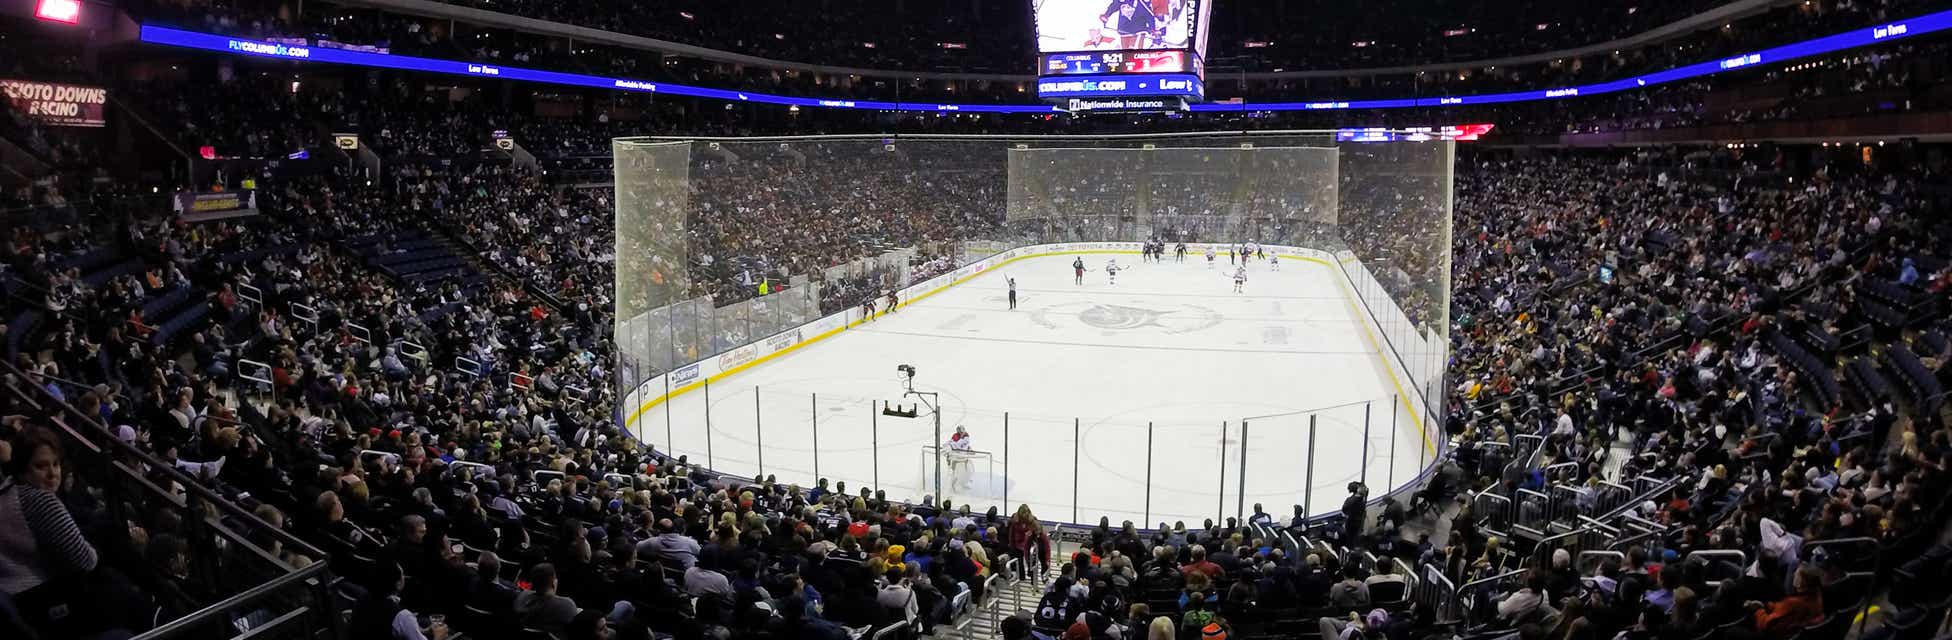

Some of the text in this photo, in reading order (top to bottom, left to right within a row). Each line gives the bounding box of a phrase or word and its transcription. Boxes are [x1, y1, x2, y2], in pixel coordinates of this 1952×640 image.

[1103, 54, 1122, 63] 9:21
[54, 86, 107, 104] DOWNS
[29, 101, 79, 116] RACINO
[1080, 100, 1163, 109] Nationwide Insurance
